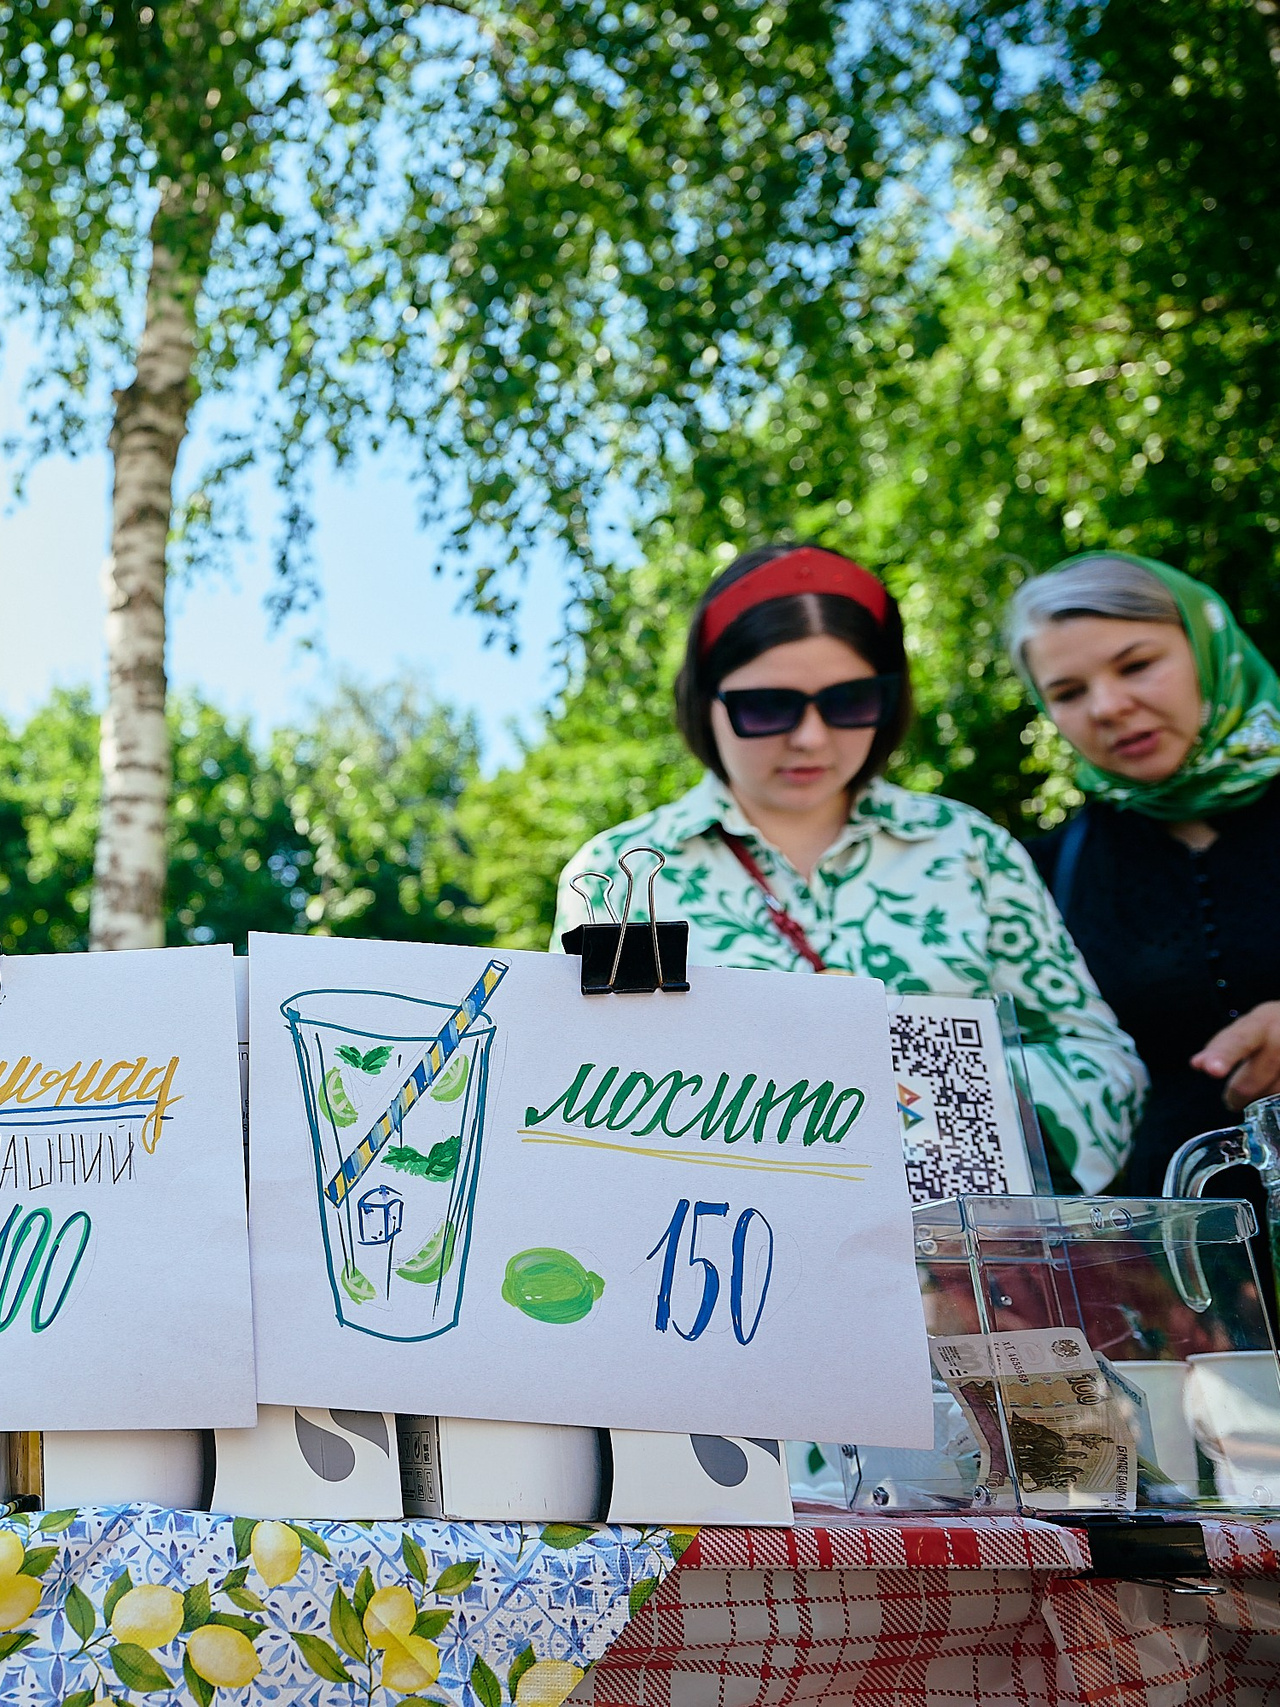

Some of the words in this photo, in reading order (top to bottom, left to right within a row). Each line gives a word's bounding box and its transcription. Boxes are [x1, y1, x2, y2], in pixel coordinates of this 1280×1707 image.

[526, 1063, 865, 1146] мохито
[646, 1198, 774, 1346] 150
[1065, 1373, 1103, 1406] 100
